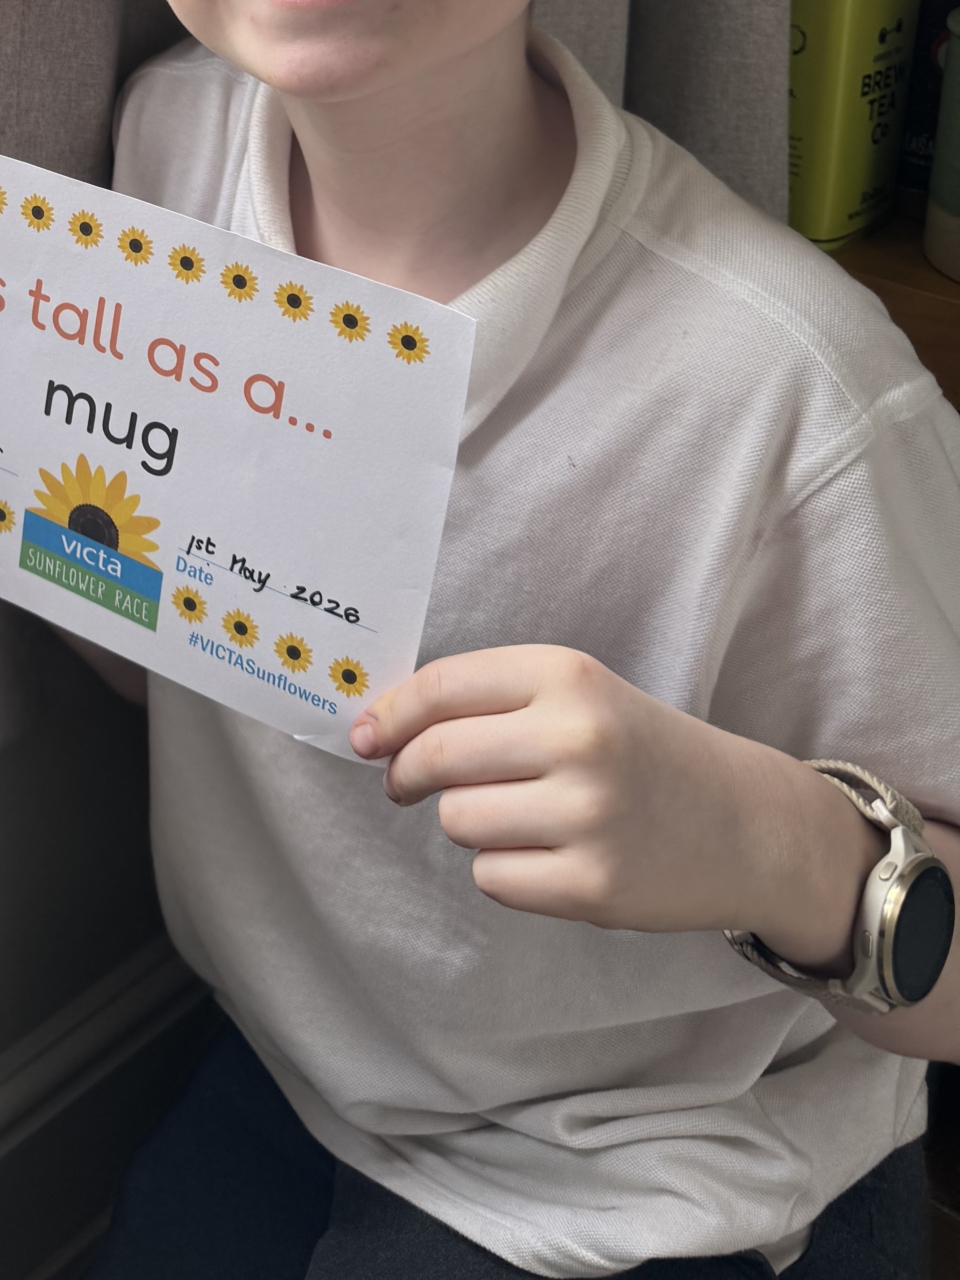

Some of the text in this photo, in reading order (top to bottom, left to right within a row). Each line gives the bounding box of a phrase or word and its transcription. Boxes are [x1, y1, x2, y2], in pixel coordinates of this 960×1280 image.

[860, 63, 905, 98] BREW
[867, 92, 895, 121] TEA
[28, 278, 124, 360] tall
[147, 337, 220, 393] as
[243, 373, 333, 440] a...
[44, 379, 179, 476] mug
[26, 548, 149, 622] SUNFLOWER RACE
[175, 555, 214, 586] Date
[186, 535, 360, 624] 1st May 2026
[188, 631, 338, 715] #VICTASunflowers
